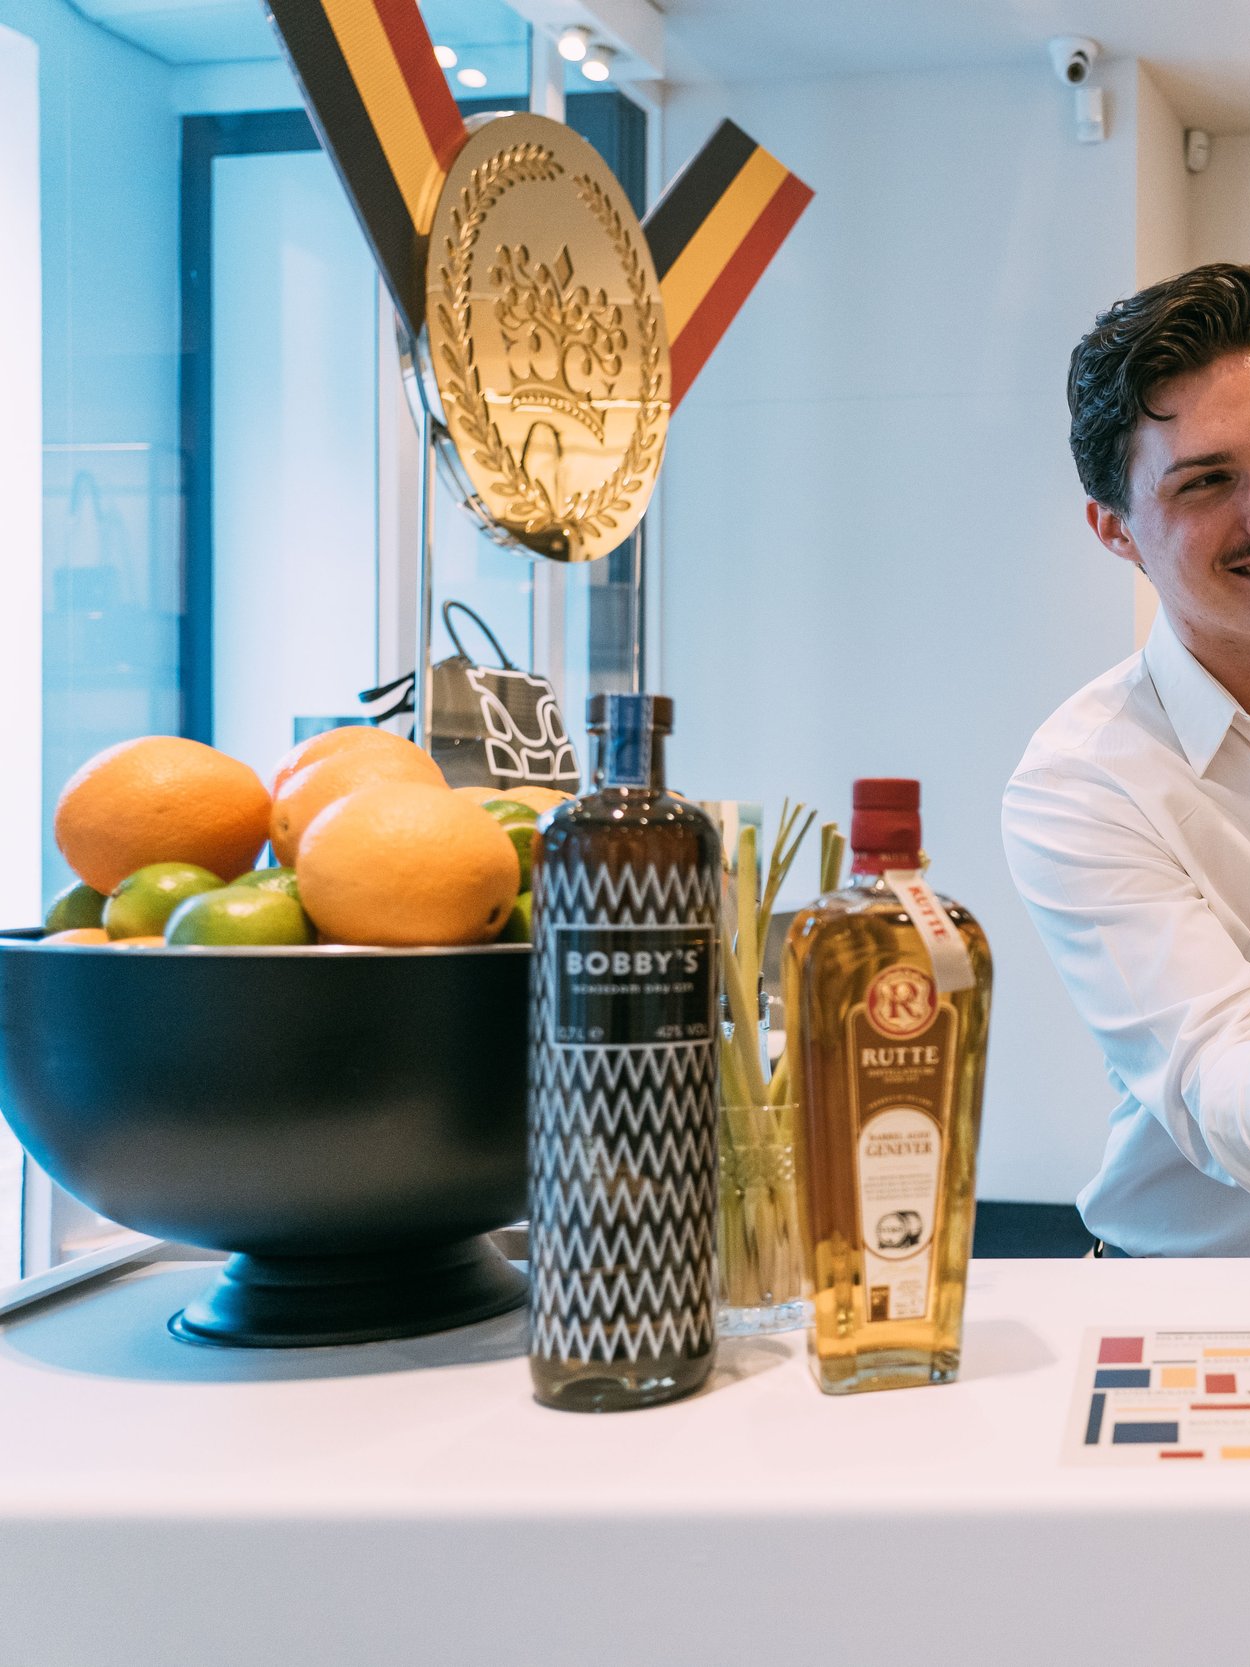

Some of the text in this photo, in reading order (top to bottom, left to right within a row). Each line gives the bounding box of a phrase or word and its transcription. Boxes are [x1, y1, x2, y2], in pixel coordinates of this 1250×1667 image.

[566, 949, 699, 976] BOBBY'S
[861, 1046, 940, 1067] RUTTE
[865, 1141, 933, 1157] GENEVER
